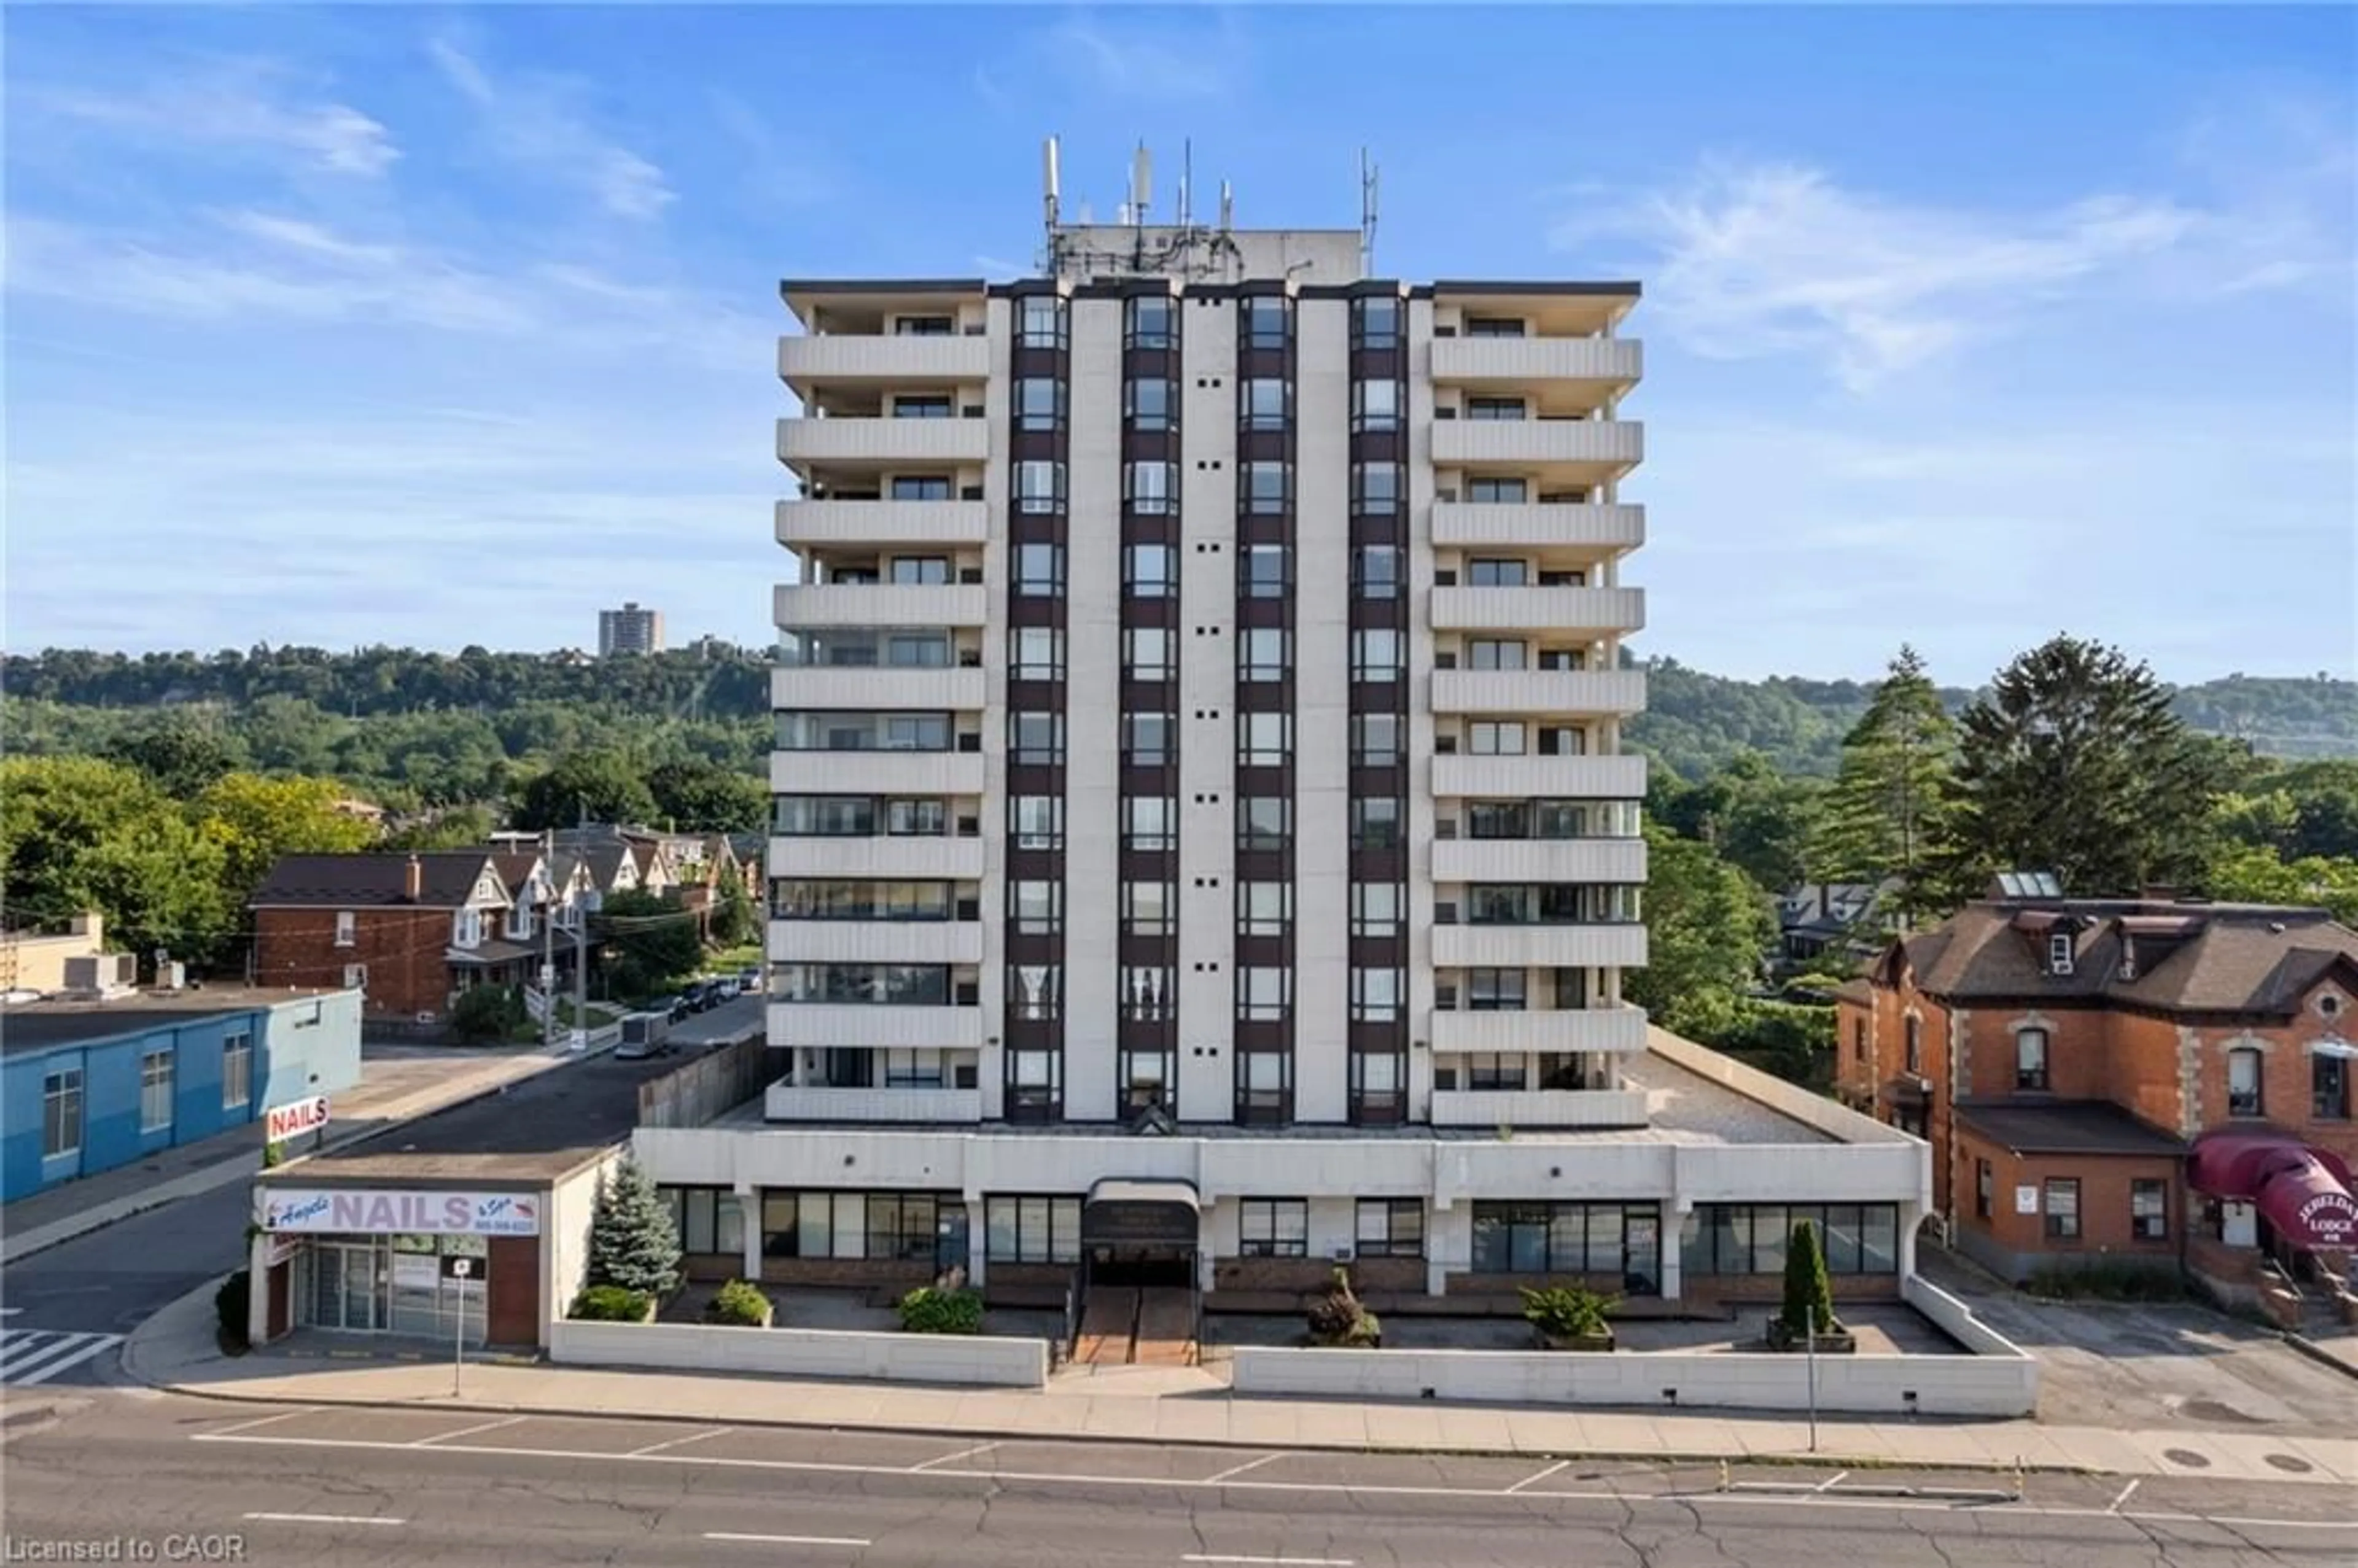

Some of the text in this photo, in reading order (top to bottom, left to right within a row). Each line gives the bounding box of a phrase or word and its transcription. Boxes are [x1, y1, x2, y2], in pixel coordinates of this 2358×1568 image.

[271, 1098, 326, 1138] NAILS
[333, 1195, 470, 1229] NAILS
[2309, 1219, 2353, 1233] LODGE
